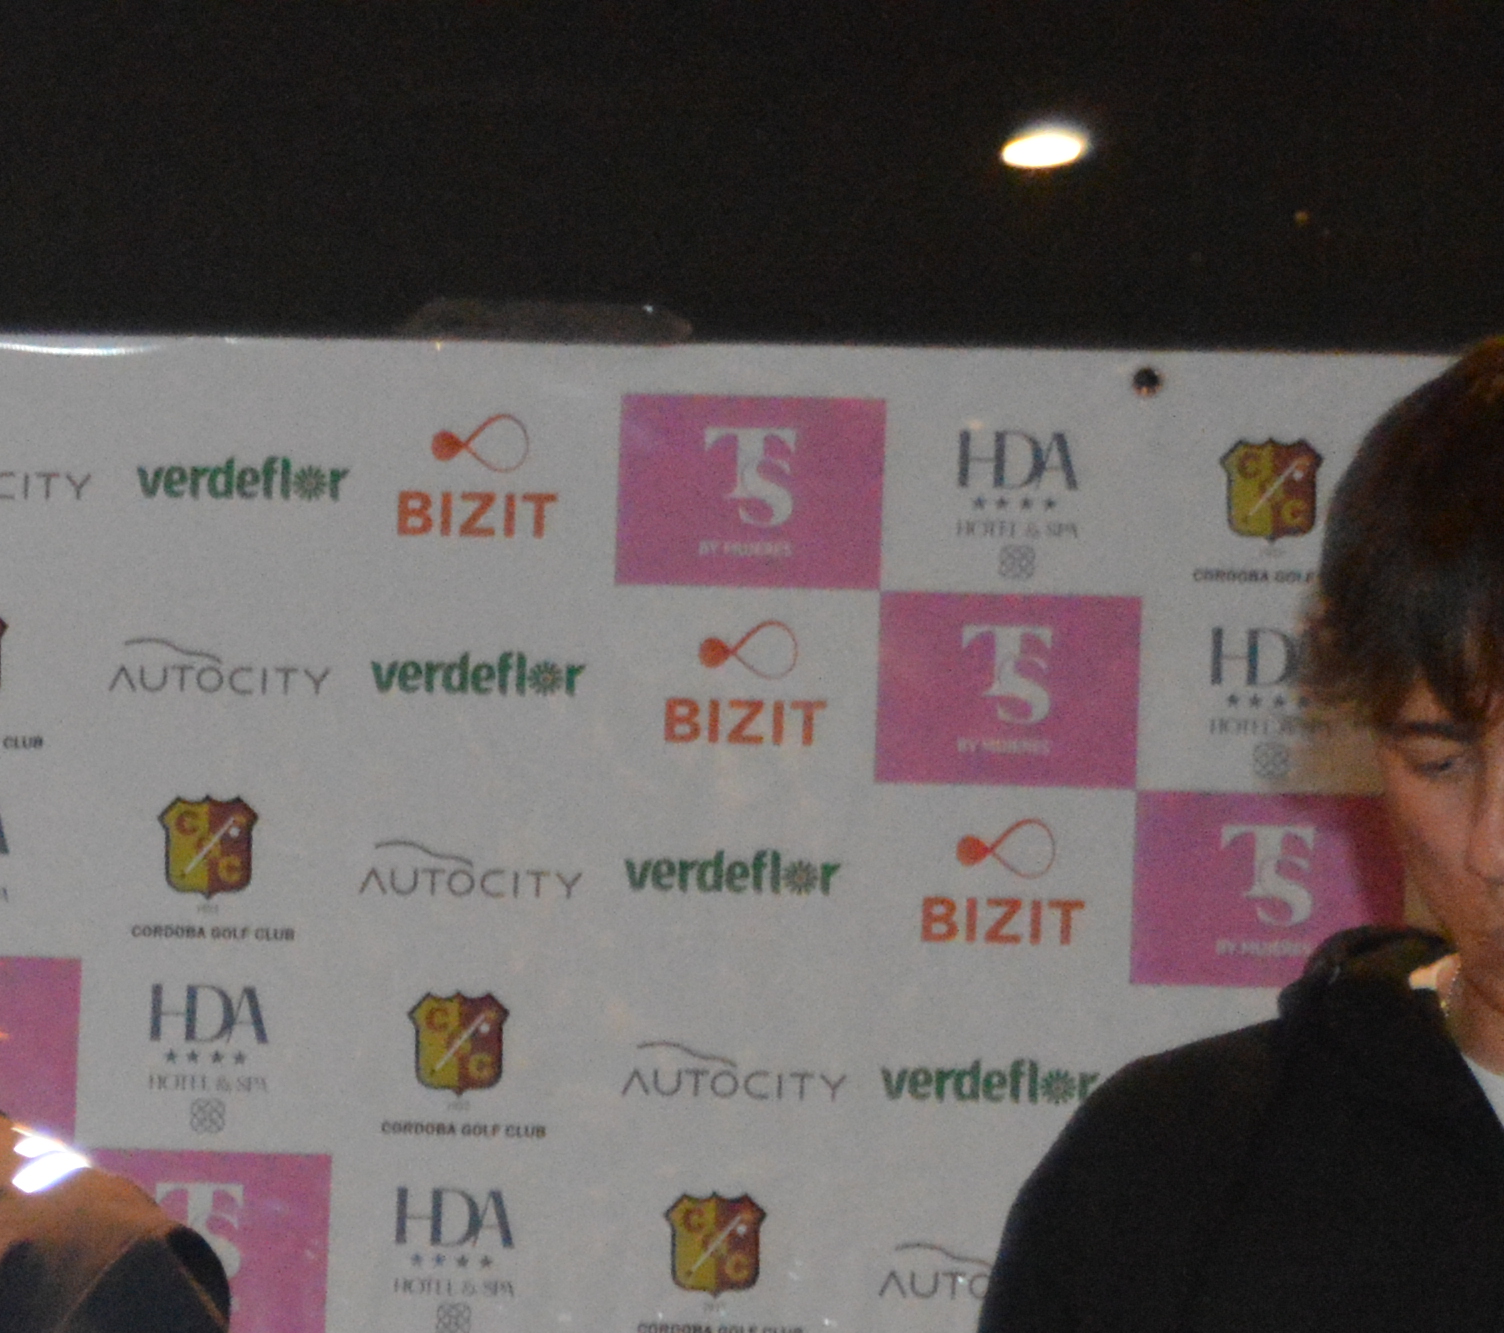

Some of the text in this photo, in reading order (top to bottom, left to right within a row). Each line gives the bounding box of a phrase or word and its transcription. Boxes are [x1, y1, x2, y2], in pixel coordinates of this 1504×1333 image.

[957, 429, 1079, 492] HDA
[397, 490, 559, 539] BIZIT
[109, 664, 332, 697] AUTOCITY
[3, 735, 44, 751] CLUB
[663, 698, 826, 747] BIZIT
[358, 868, 583, 901] AUTOCITY
[211, 926, 249, 941] GOLF
[254, 927, 295, 942] CLUB
[921, 896, 1085, 946] BIZIT
[150, 984, 270, 1045] HDA
[621, 1068, 846, 1101] AUTOCITY
[395, 1186, 515, 1249] HDA
